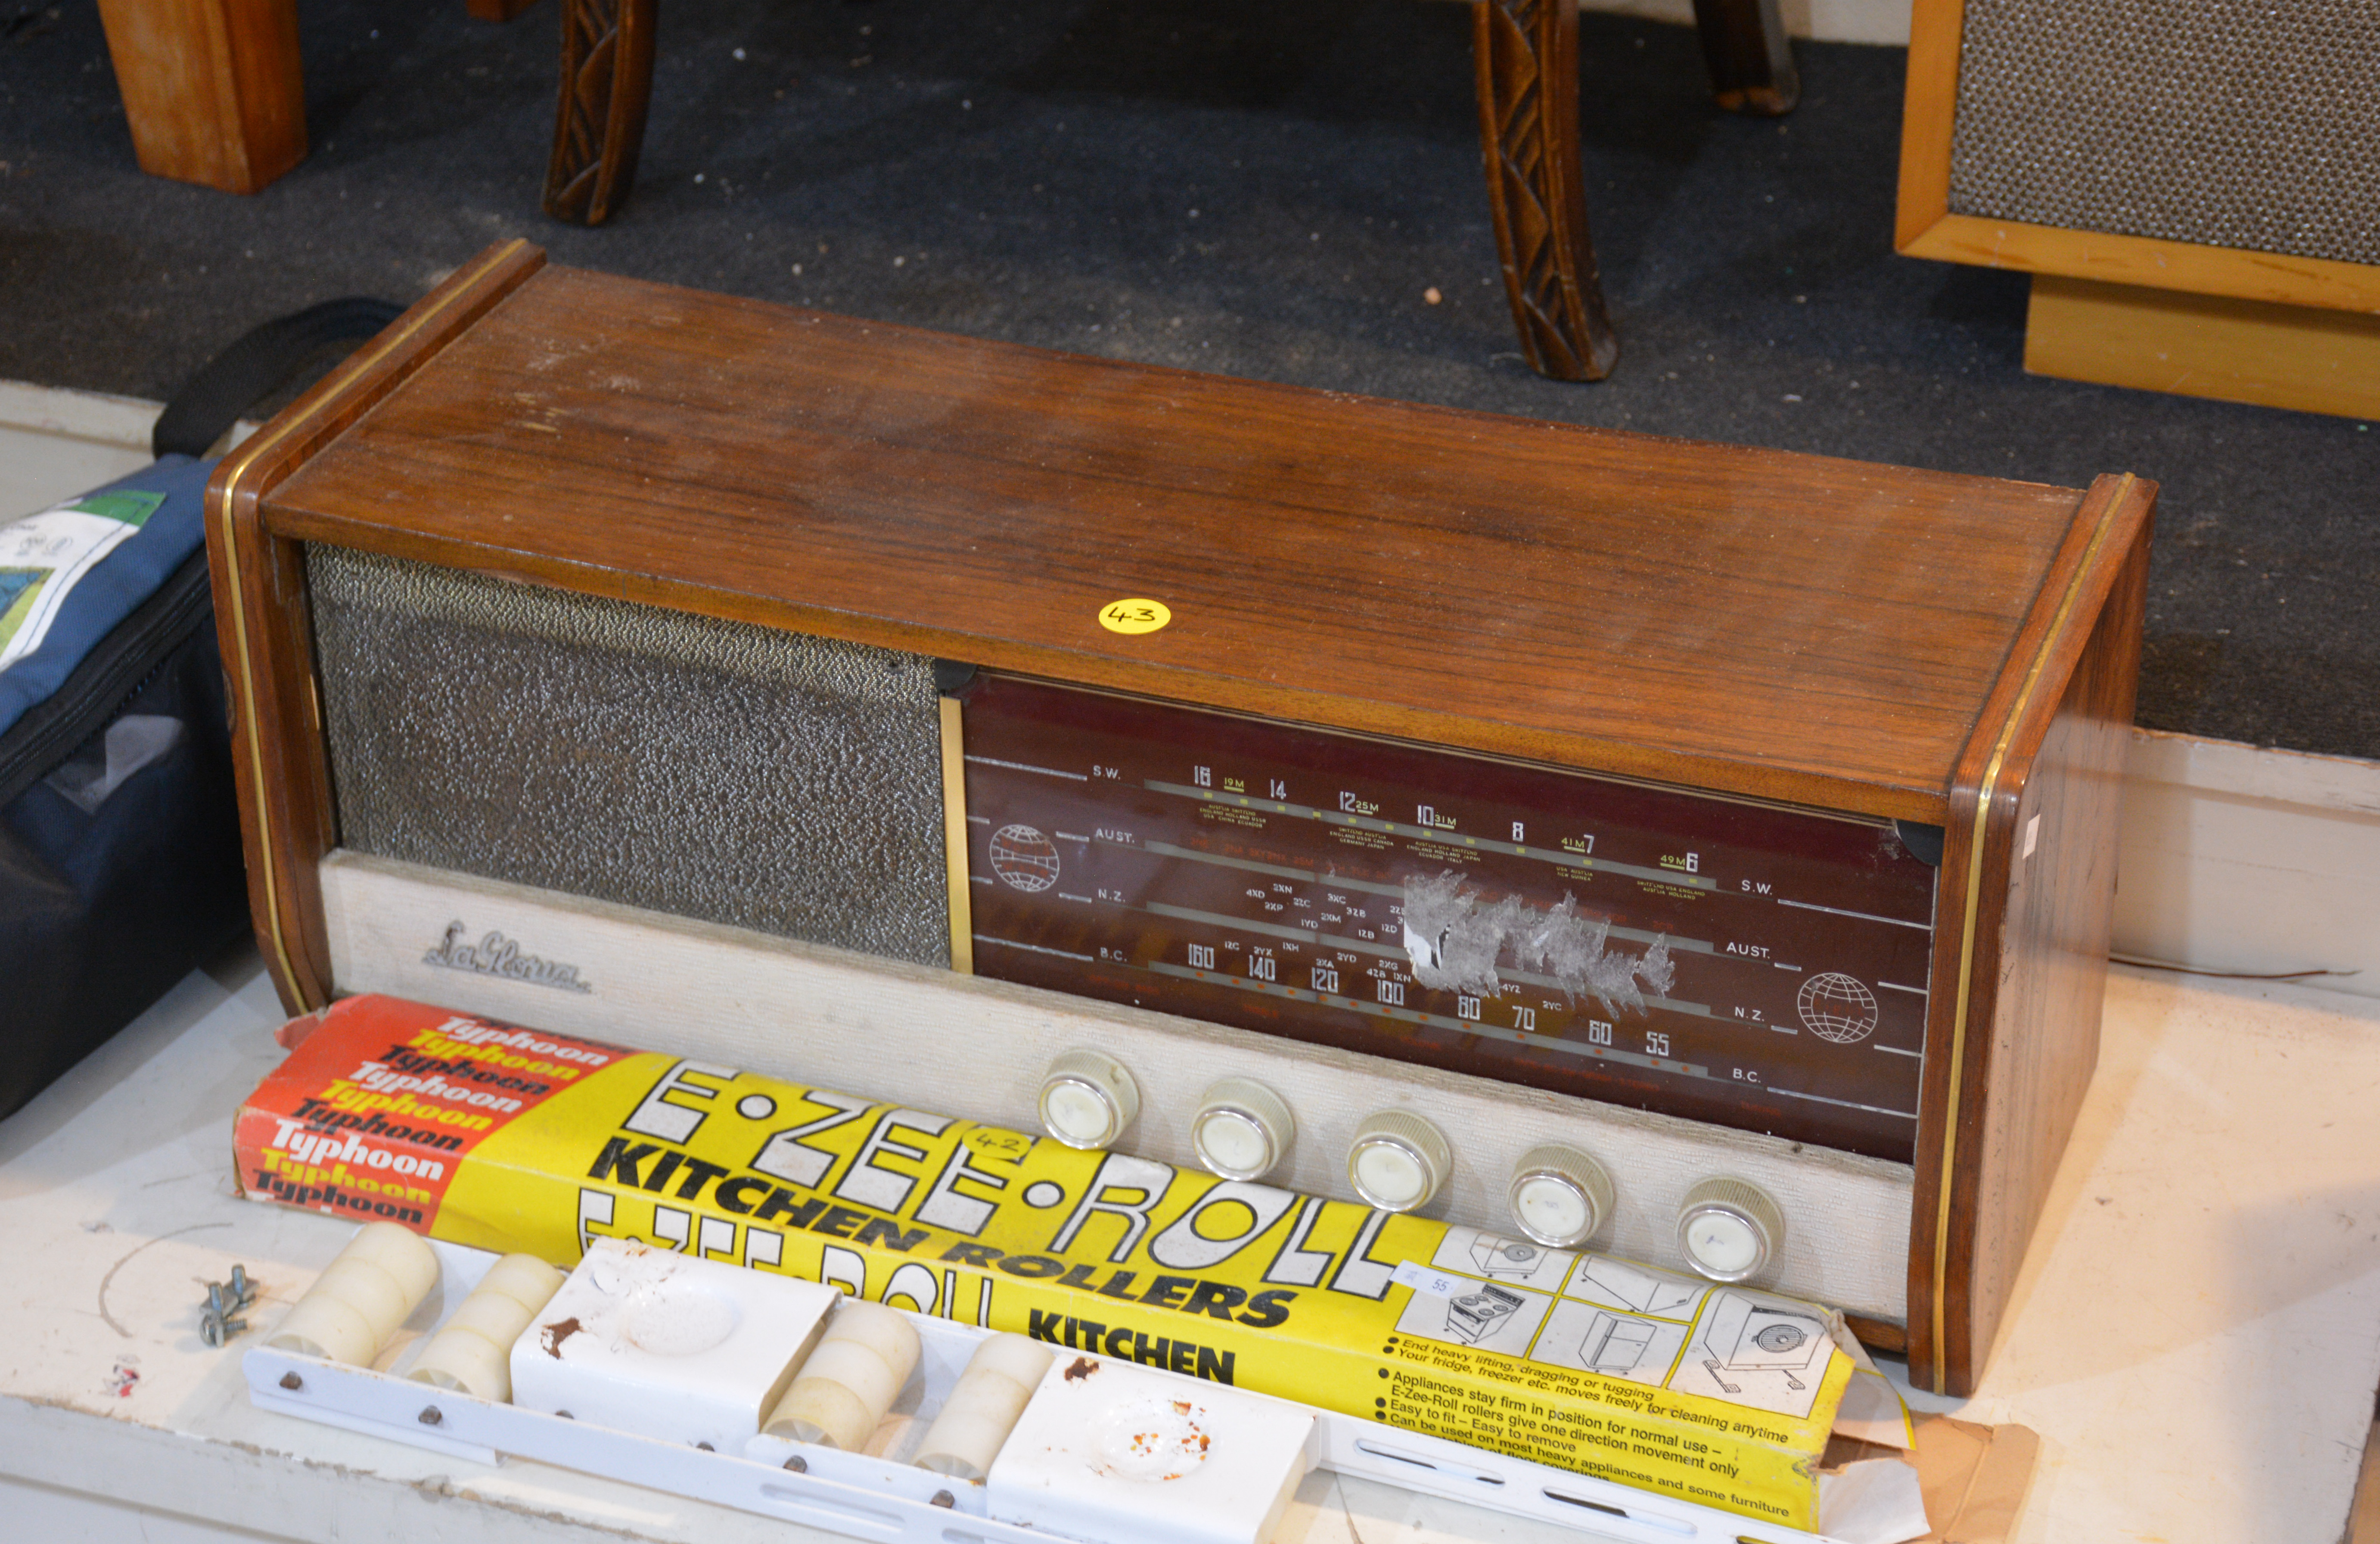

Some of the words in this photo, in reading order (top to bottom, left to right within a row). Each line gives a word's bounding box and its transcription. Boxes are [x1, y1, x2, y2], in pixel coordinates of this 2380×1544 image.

[1108, 606, 1156, 623] 43
[1094, 765, 1121, 781] S.W.
[1194, 765, 1211, 788] 16
[1271, 779, 1286, 800] 14
[1340, 791, 1355, 812] 12
[1199, 807, 1223, 816] ENGLAND
[1225, 812, 1250, 820] HOLLAND
[1238, 820, 1263, 828] ECUADOR
[1417, 804, 1434, 826] 10
[1096, 828, 1134, 844] AUST.
[1330, 831, 1355, 839] ENGLAND
[1373, 838, 1394, 846] CANADA
[1339, 838, 1365, 846] GERMANY
[1512, 822, 1524, 842] 8
[1407, 844, 1432, 853] ENGLAND
[1435, 850, 1460, 858] HOLLAND
[1583, 834, 1594, 853] 7
[1419, 852, 1444, 860] ECUADOR
[1686, 852, 1698, 872] 6
[1098, 888, 1126, 903] N.Z.
[1246, 889, 1265, 899] 4XD
[1328, 893, 1346, 904] 3XC
[1668, 891, 1696, 900] HOLLAND
[1679, 888, 1705, 896] ENGLAND
[1742, 880, 1773, 896] S.W.
[1100, 947, 1127, 962] B.C.
[1188, 943, 1214, 969] 160
[1726, 942, 1770, 959] AUST.
[1249, 954, 1275, 982] 140
[1311, 966, 1338, 993] 120
[1377, 979, 1404, 1006] 100
[1457, 995, 1480, 1021] 80
[1512, 1005, 1535, 1031] 70
[1735, 1006, 1765, 1021] N.Z.
[437, 1016, 609, 1066] Typhoon
[1588, 1019, 1612, 1046] 60
[1646, 1030, 1669, 1057] 55
[408, 1028, 580, 1080] Typhoon
[378, 1044, 550, 1095] Typhoon
[1733, 1068, 1761, 1083] B.C.
[348, 1060, 522, 1113] Typhoon
[319, 1078, 493, 1131] Typhoon
[290, 1096, 464, 1151] Typhoon
[271, 1118, 444, 1182] Typhoon
[976, 1133, 1020, 1152] 42
[261, 1147, 432, 1205] Typhoon
[253, 1169, 423, 1224] Typhoon
[587, 1136, 930, 1252] KITCHEN
[939, 1240, 1301, 1328] ROLLERS
[1432, 1279, 1450, 1292] 55
[1029, 1308, 1236, 1385] KITCHEN
[1403, 1339, 1429, 1352] End
[1432, 1346, 1472, 1362] heavy
[1476, 1355, 1514, 1373] lifting,
[1520, 1363, 1580, 1385] dragging
[1584, 1379, 1599, 1388] or
[1603, 1382, 1654, 1402] tugging
[1399, 1348, 1429, 1362] Your
[1432, 1354, 1473, 1374] fridge,
[1479, 1366, 1524, 1384] freezer
[1527, 1378, 1550, 1391] etc.
[1555, 1385, 1600, 1401] moves
[1605, 1393, 1643, 1412] freely
[1647, 1403, 1666, 1415] for
[1671, 1408, 1728, 1431] cleaning
[1733, 1422, 1789, 1444] anytime
[1393, 1371, 1464, 1397] Appliances
[1469, 1390, 1496, 1407] stay
[1501, 1395, 1526, 1412] firm
[1532, 1402, 1544, 1416] in
[1548, 1407, 1603, 1429] position
[1607, 1420, 1627, 1434] for
[1630, 1427, 1678, 1447] normal
[1683, 1440, 1708, 1454] use
[1391, 1399, 1422, 1418] Easy
[1427, 1408, 1440, 1419] to
[1443, 1413, 1456, 1424] fit
[1473, 1419, 1504, 1437] Easy
[1509, 1427, 1522, 1439] to
[1526, 1433, 1576, 1453] remove
[1392, 1385, 1457, 1410] E-Zee-Roll
[1462, 1403, 1504, 1422] rollers
[1509, 1414, 1537, 1430] give
[1541, 1423, 1566, 1436] one
[1570, 1429, 1628, 1451] direction
[1633, 1443, 1705, 1469] movement
[1709, 1462, 1739, 1479] only
[1390, 1413, 1416, 1427] Can
[1420, 1419, 1436, 1431] be
[1441, 1425, 1473, 1439] used
[1477, 1433, 1495, 1444] on
[1499, 1439, 1532, 1454] most
[1537, 1448, 1576, 1465] heavy
[1581, 1460, 1653, 1483] appliances
[1658, 1476, 1683, 1490] and
[1687, 1484, 1726, 1500] some
[1731, 1494, 1790, 1517] furniture
